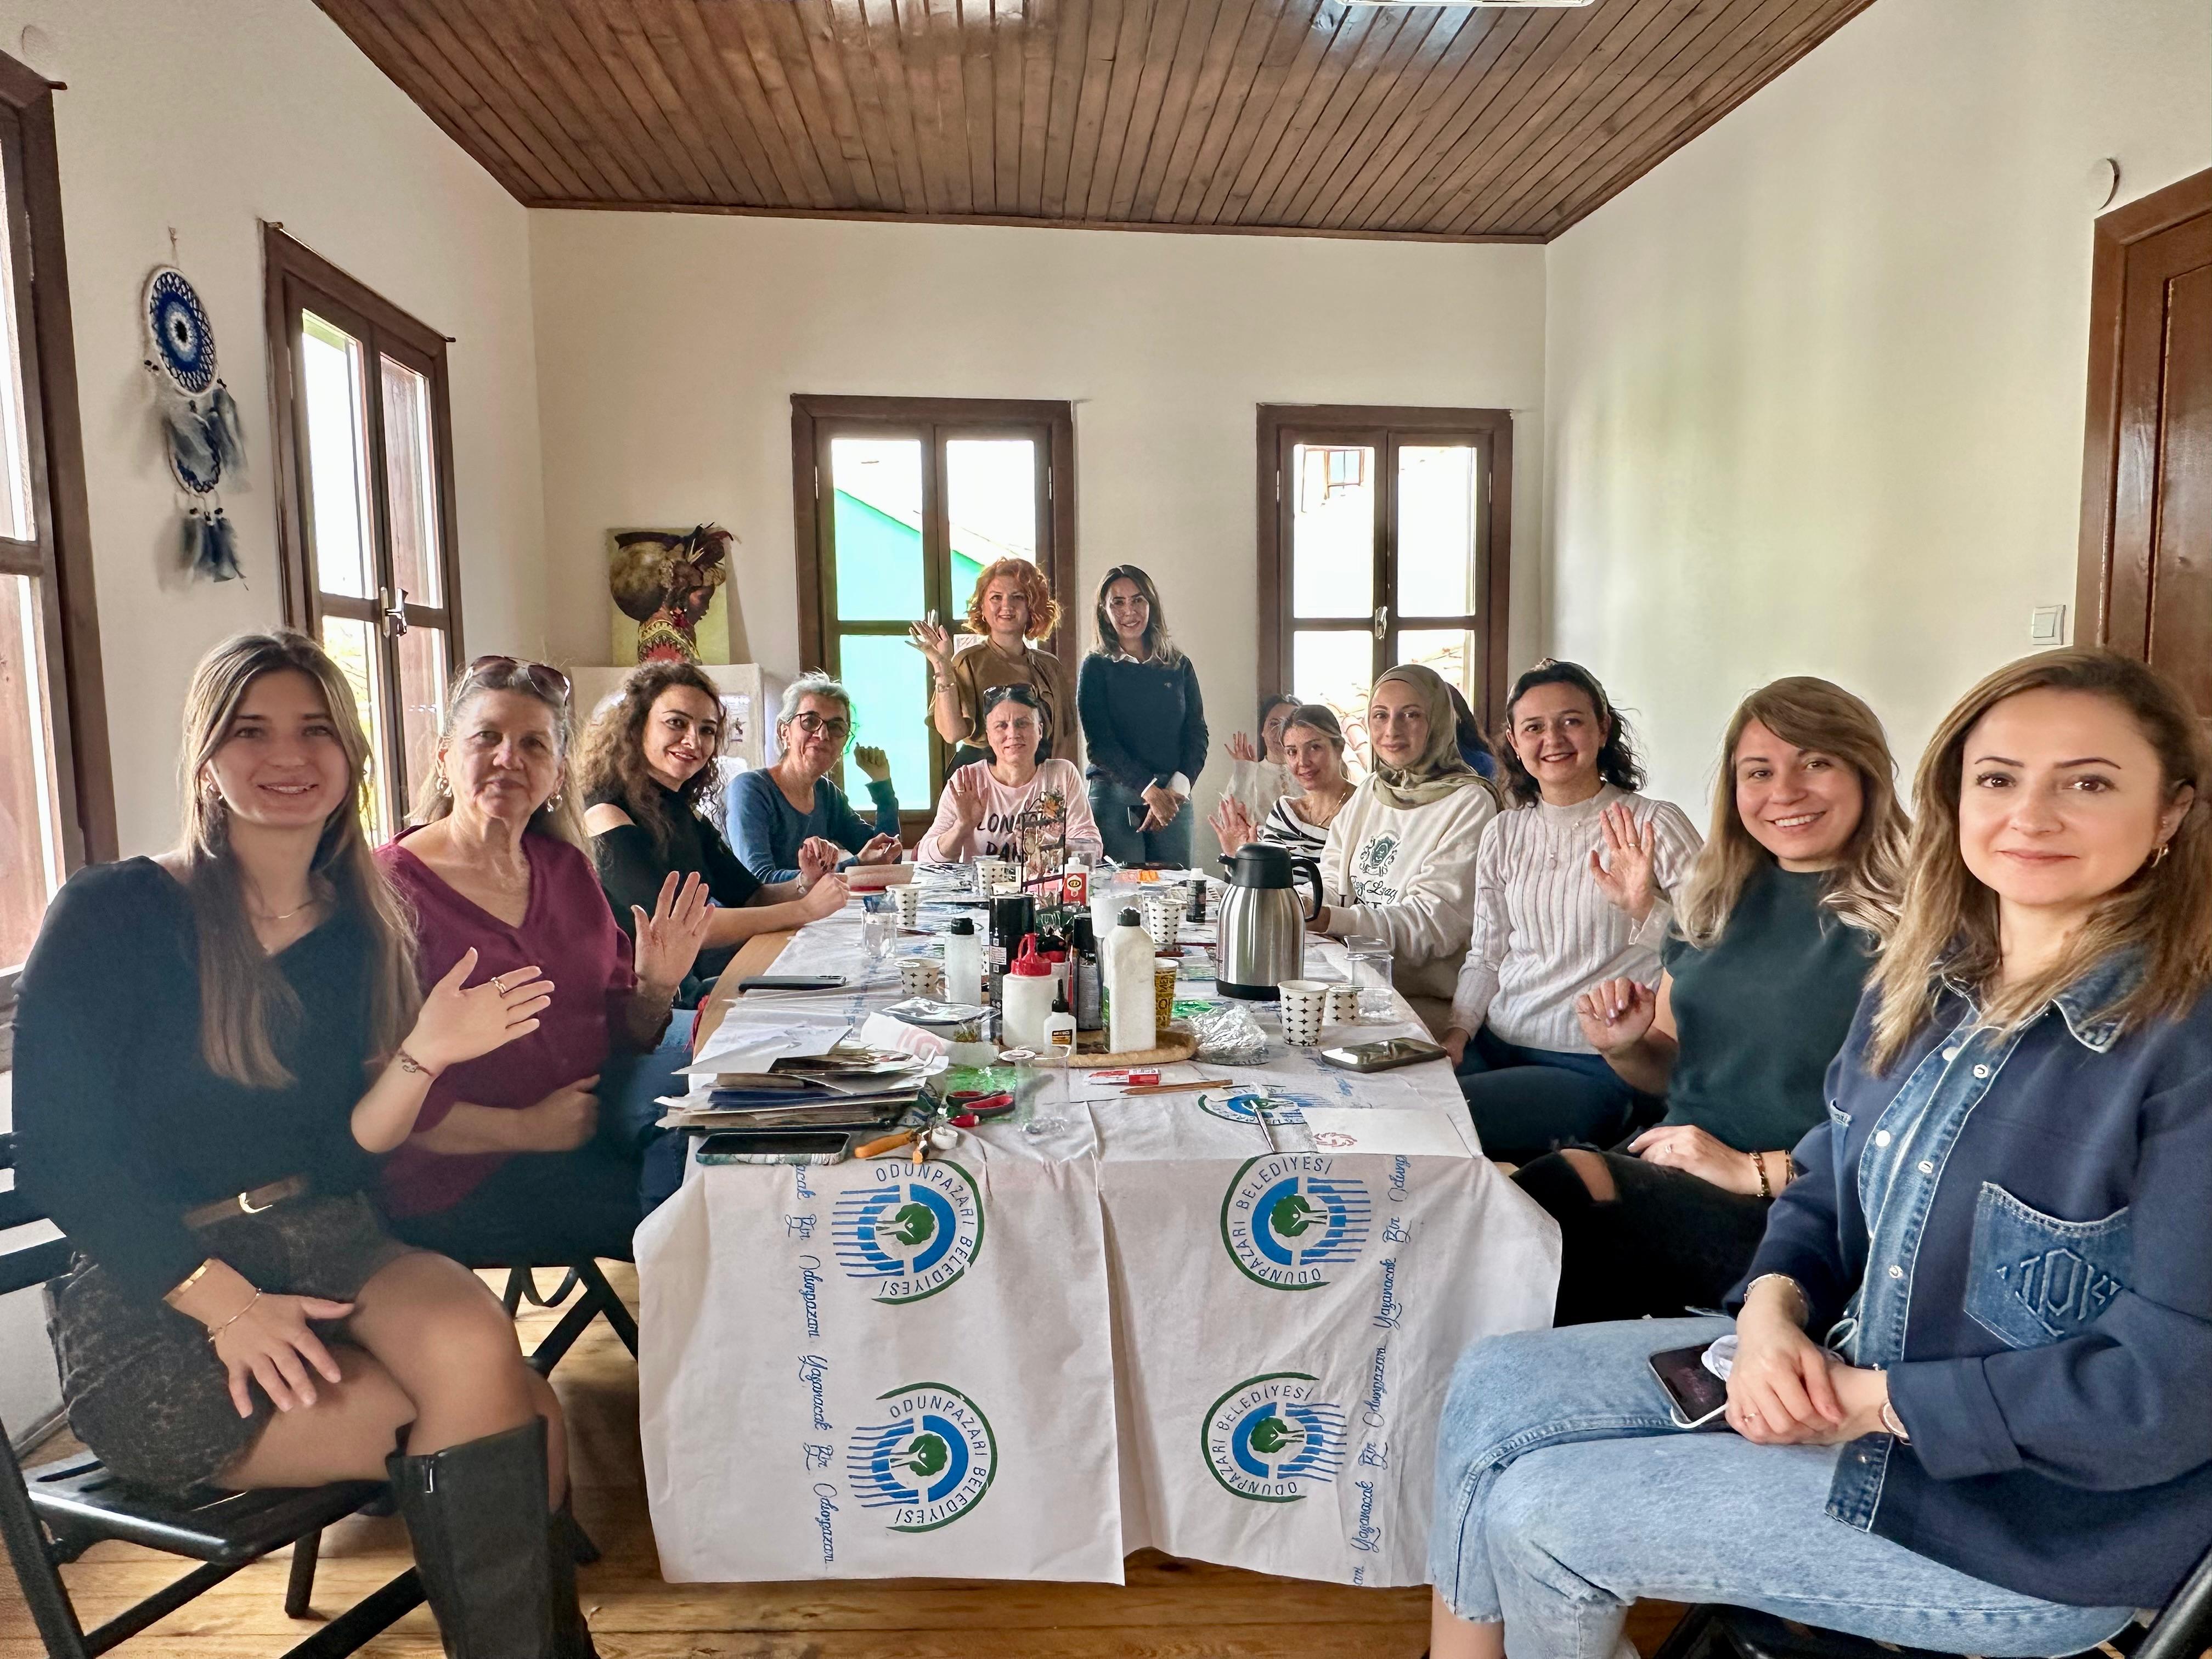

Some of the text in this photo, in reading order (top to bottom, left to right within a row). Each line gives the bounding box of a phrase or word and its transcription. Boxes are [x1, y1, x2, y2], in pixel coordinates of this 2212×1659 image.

[876, 1163, 975, 1226] ODUNPAZARI
[1232, 1221, 1322, 1285] ODUNPAZARI
[889, 1395, 988, 1456] ODUNPAZARI
[1212, 1438, 1298, 1496] ODUNPAZARI
